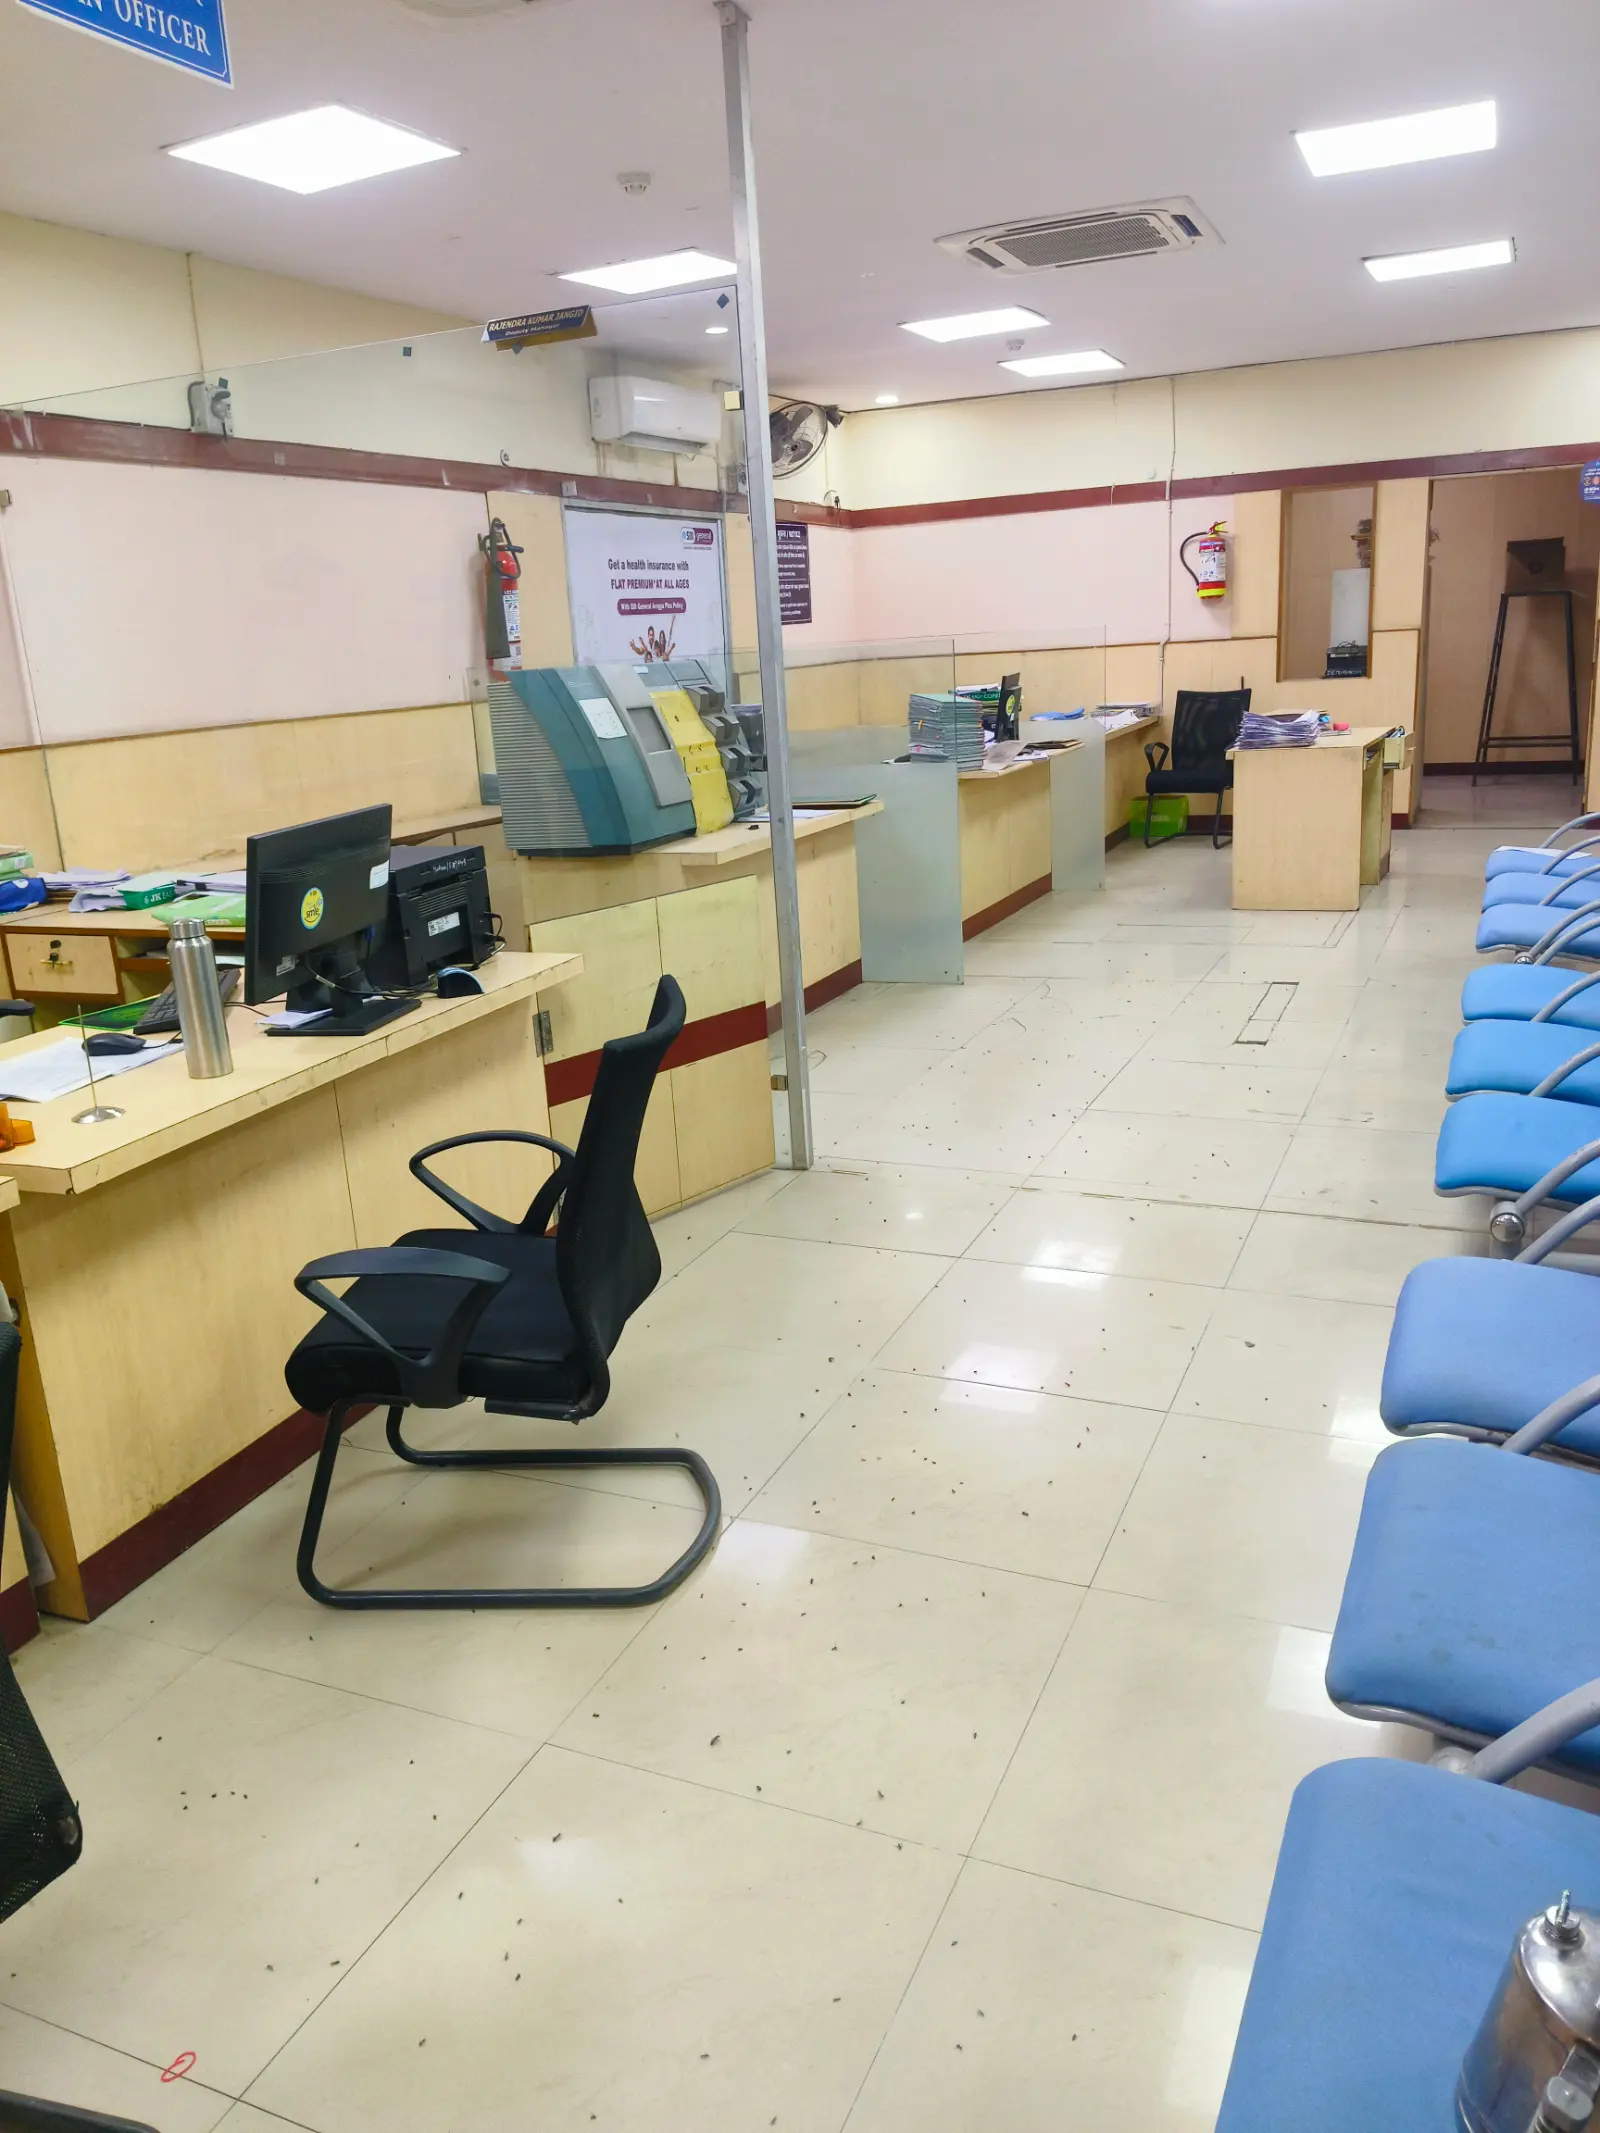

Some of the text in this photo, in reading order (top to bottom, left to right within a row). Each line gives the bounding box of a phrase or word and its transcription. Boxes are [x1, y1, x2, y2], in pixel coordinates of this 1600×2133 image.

[114, 0, 211, 56] OFFICER
[489, 319, 527, 332] RAJENDRA
[528, 314, 555, 325] KUMAR
[505, 324, 560, 336] Deputy Manager
[608, 558, 689, 571] Get a health insurance with
[611, 579, 625, 589] FLAT
[656, 579, 663, 588] AT
[664, 579, 674, 589] ALL
[676, 579, 689, 588] AGES
[150, 893, 162, 903] JK
